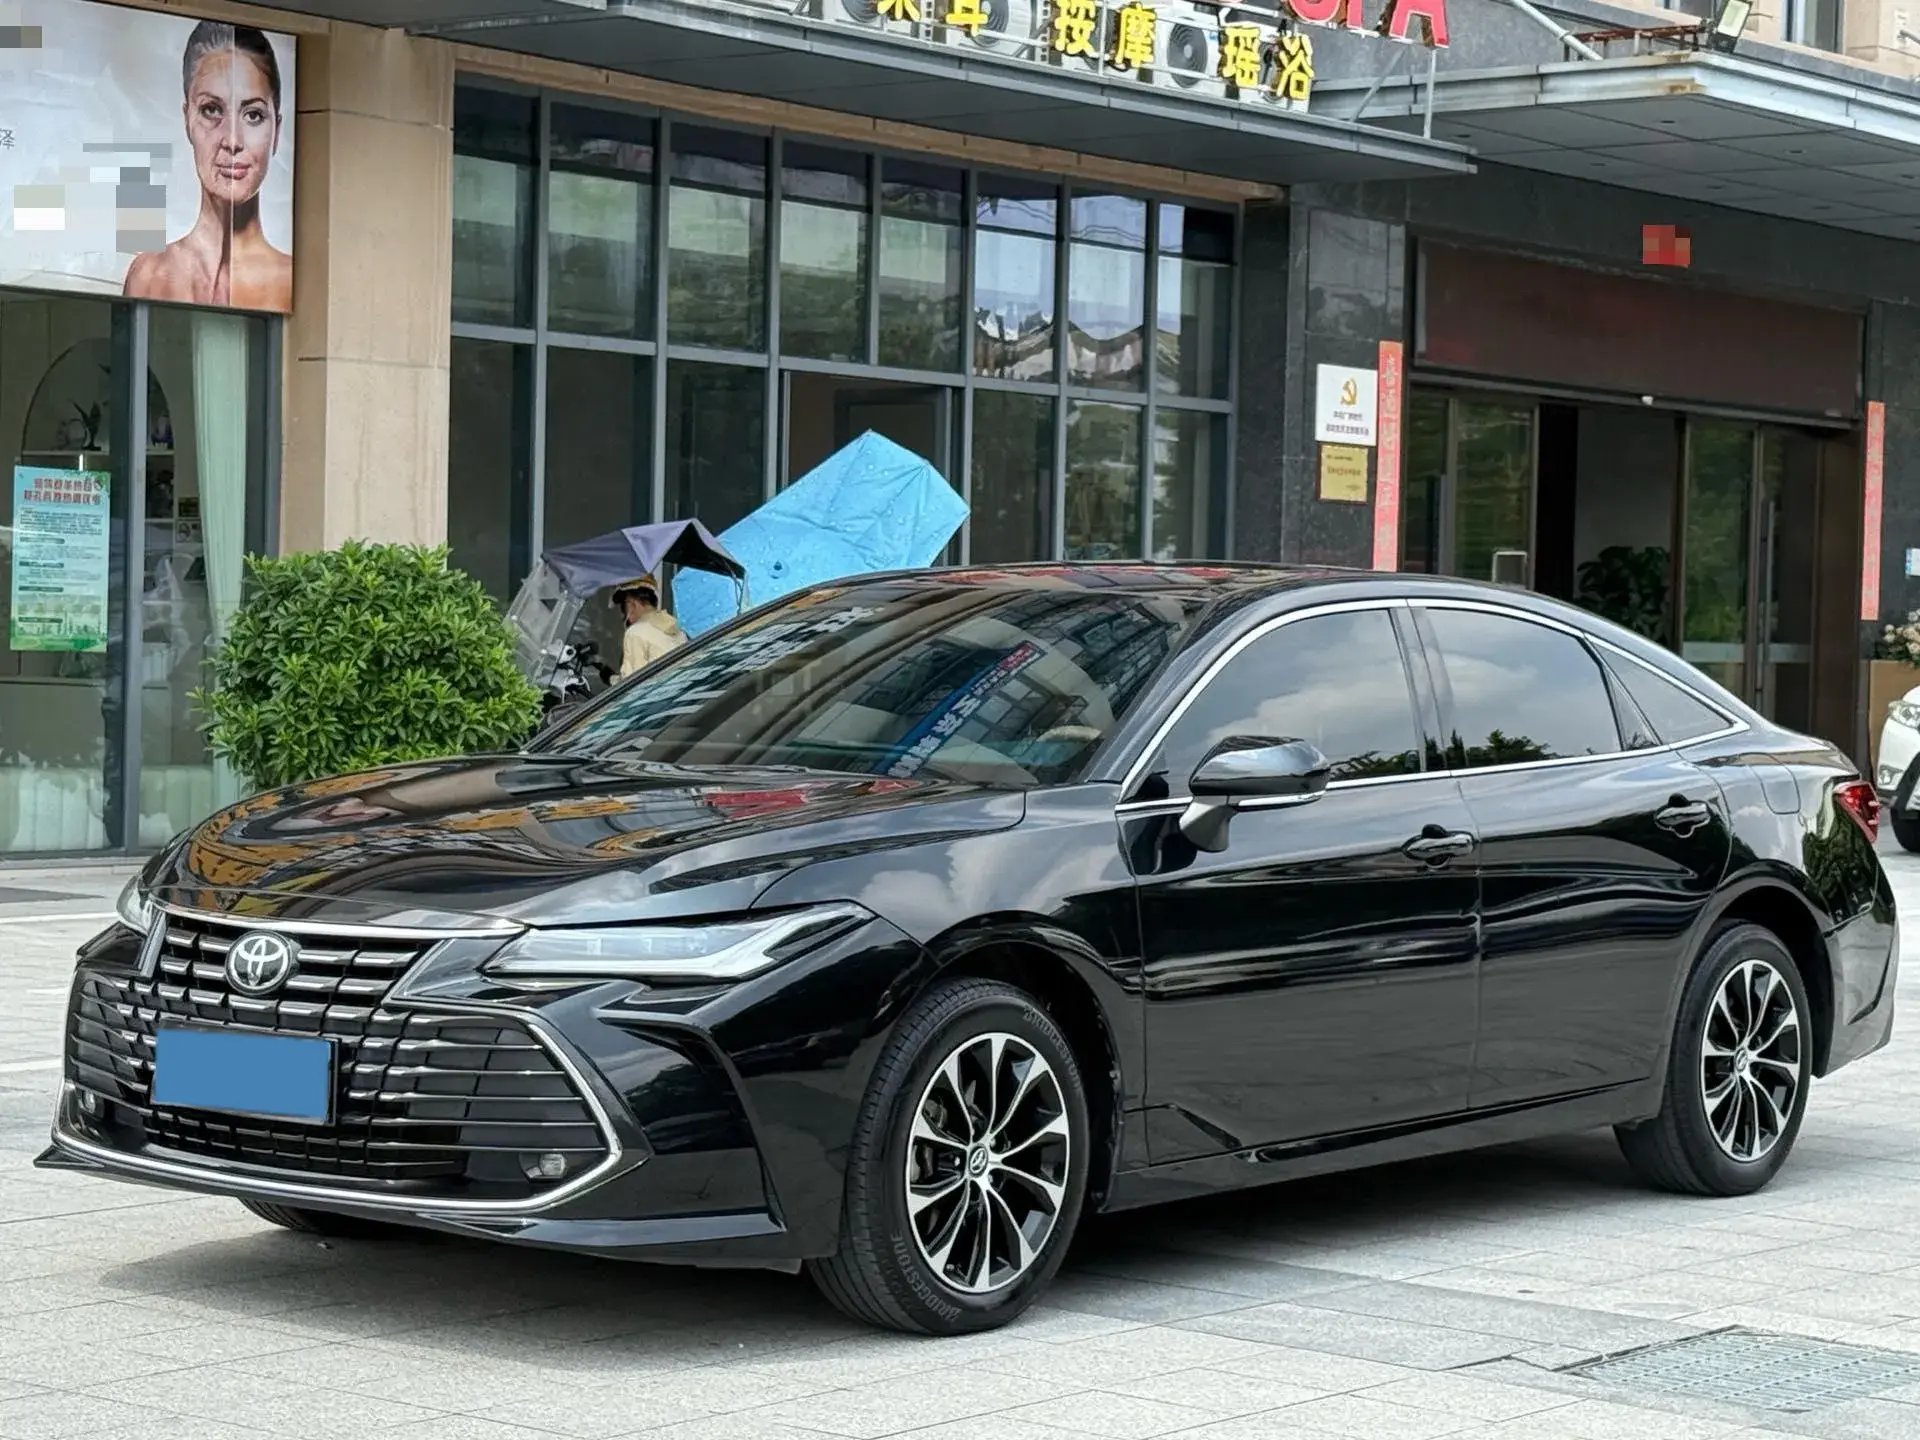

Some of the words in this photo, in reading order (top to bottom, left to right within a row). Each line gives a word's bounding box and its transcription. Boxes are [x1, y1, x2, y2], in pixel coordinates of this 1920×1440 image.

[1054, 0, 1158, 67] 按摩
[1221, 26, 1315, 100] 瑶浴
[890, 1231, 962, 1322] BRIDGESTONE
